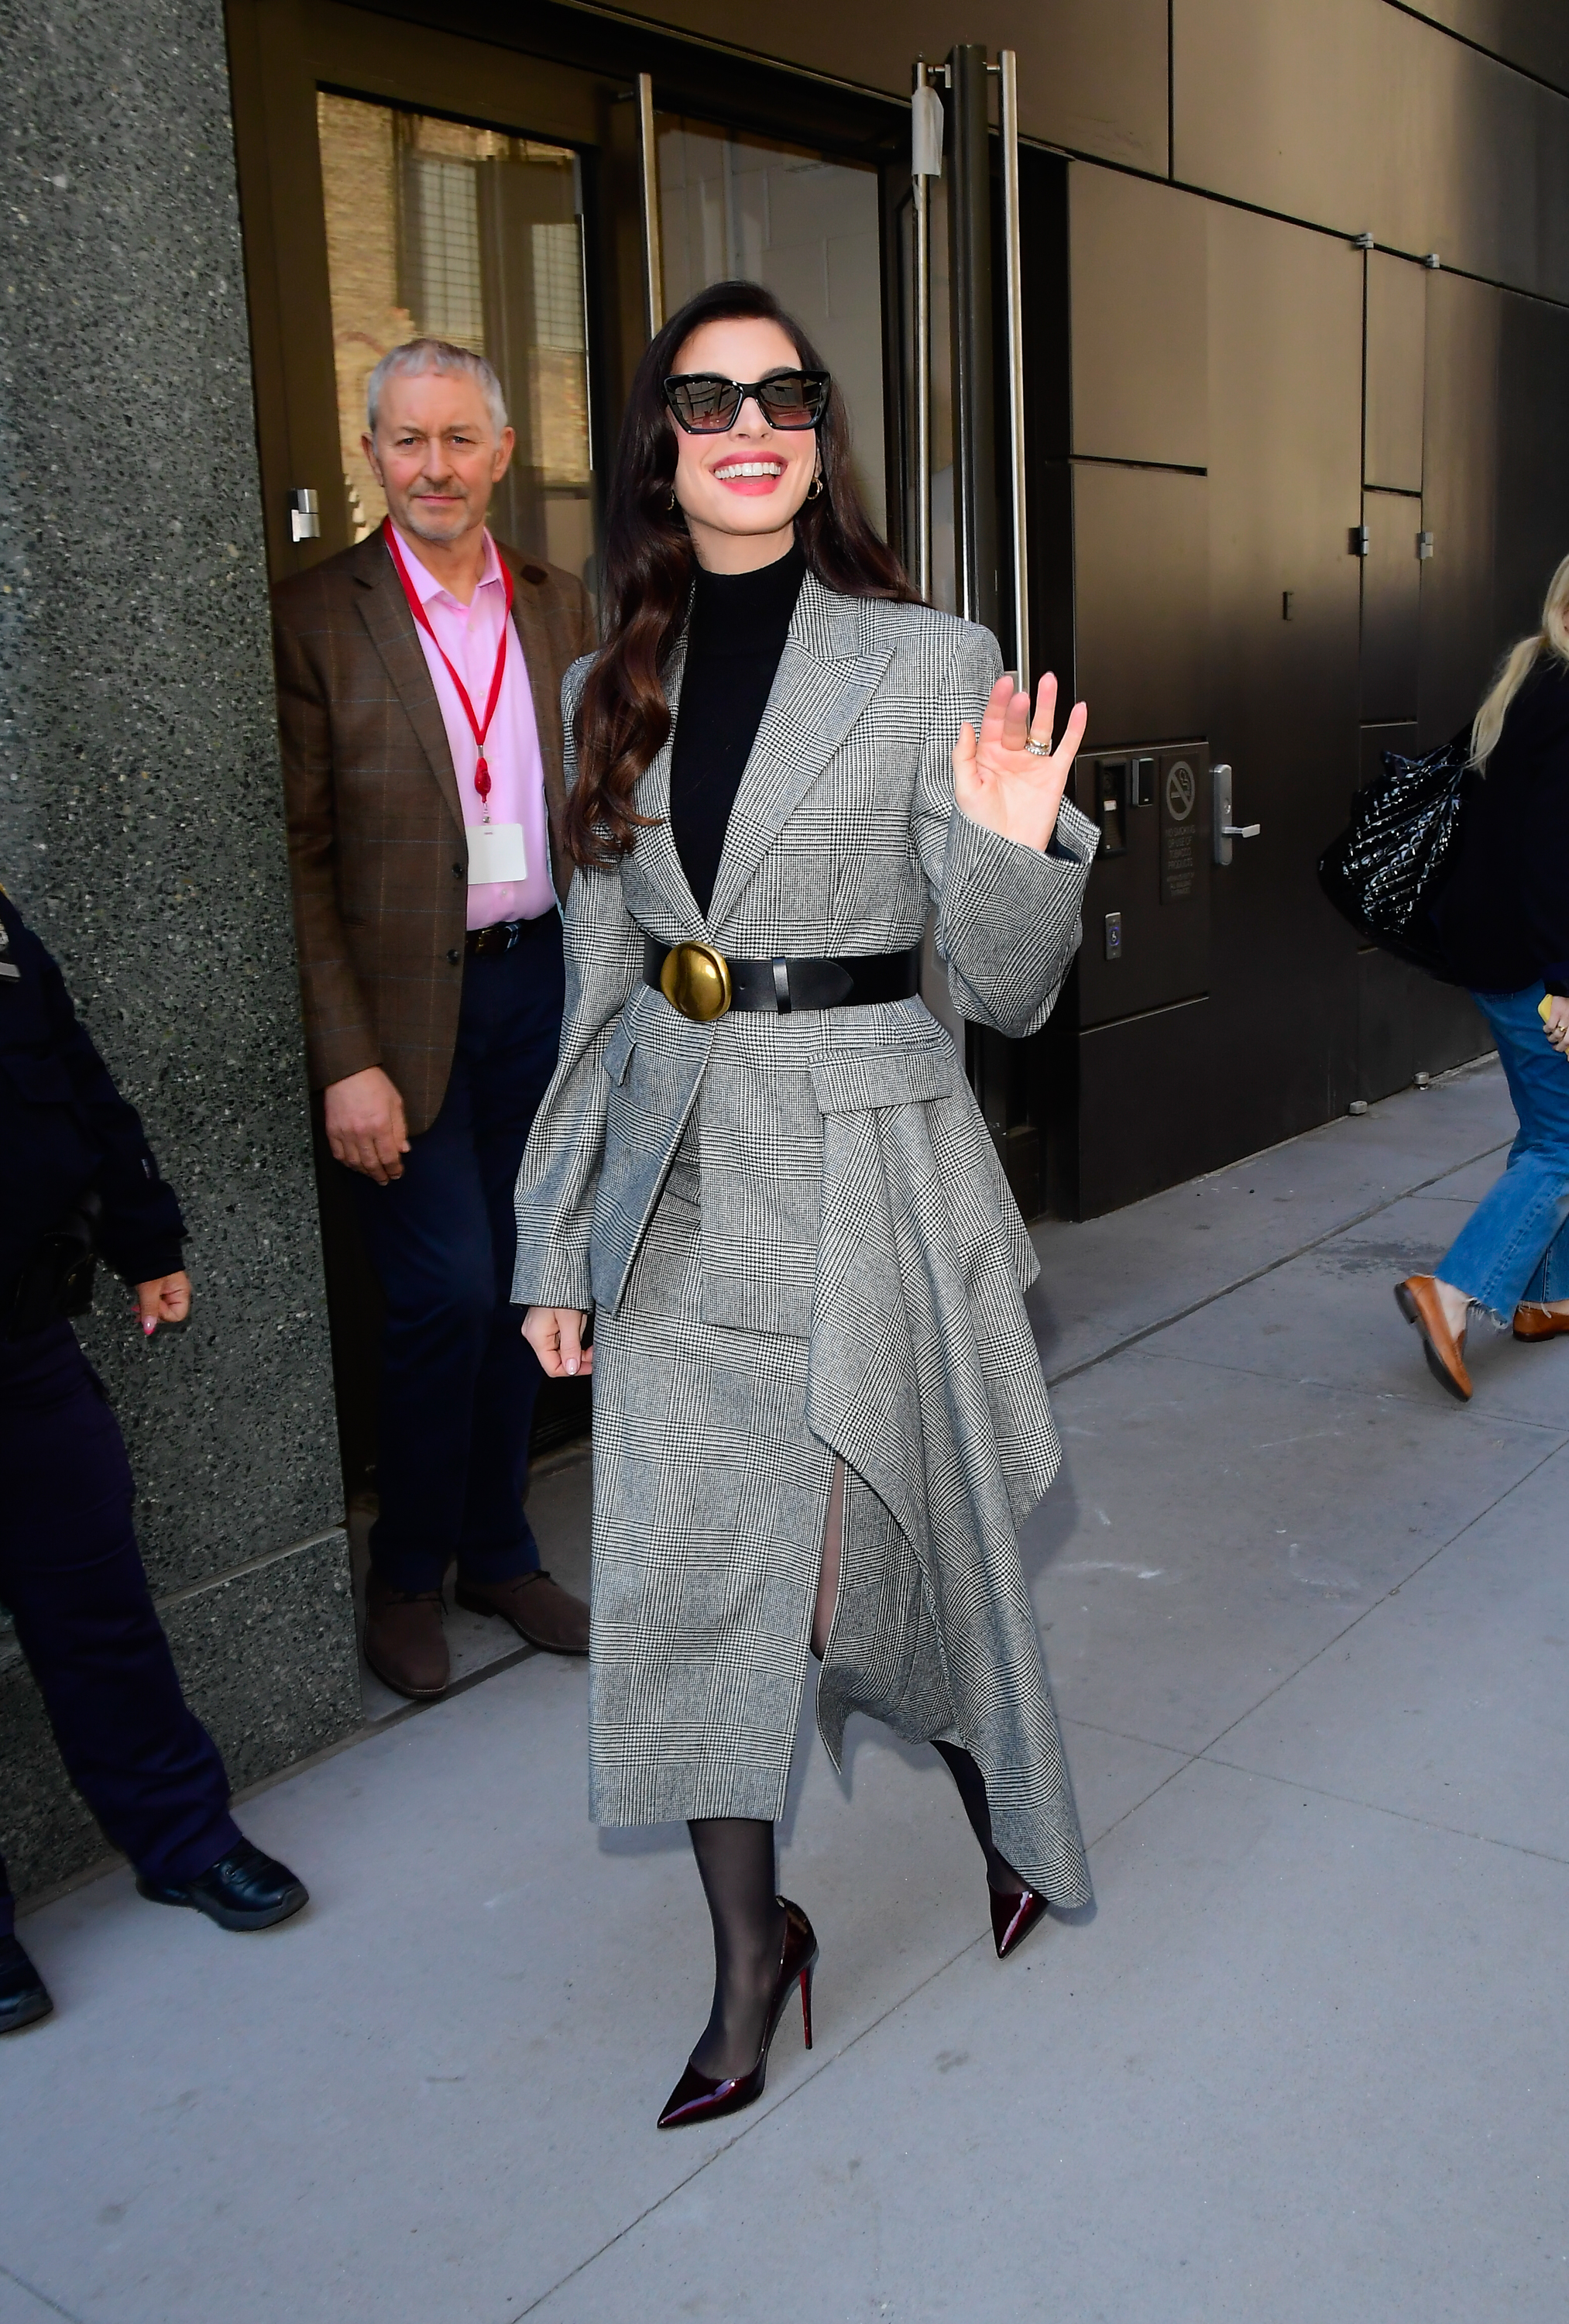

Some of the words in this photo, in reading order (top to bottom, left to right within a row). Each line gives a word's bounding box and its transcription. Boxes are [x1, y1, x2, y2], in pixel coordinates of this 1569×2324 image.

[1165, 828, 1173, 837] NO
[1173, 824, 1196, 836] SMOKING
[1185, 836, 1193, 845] OF
[1167, 858, 1193, 870] PRODUCTS
